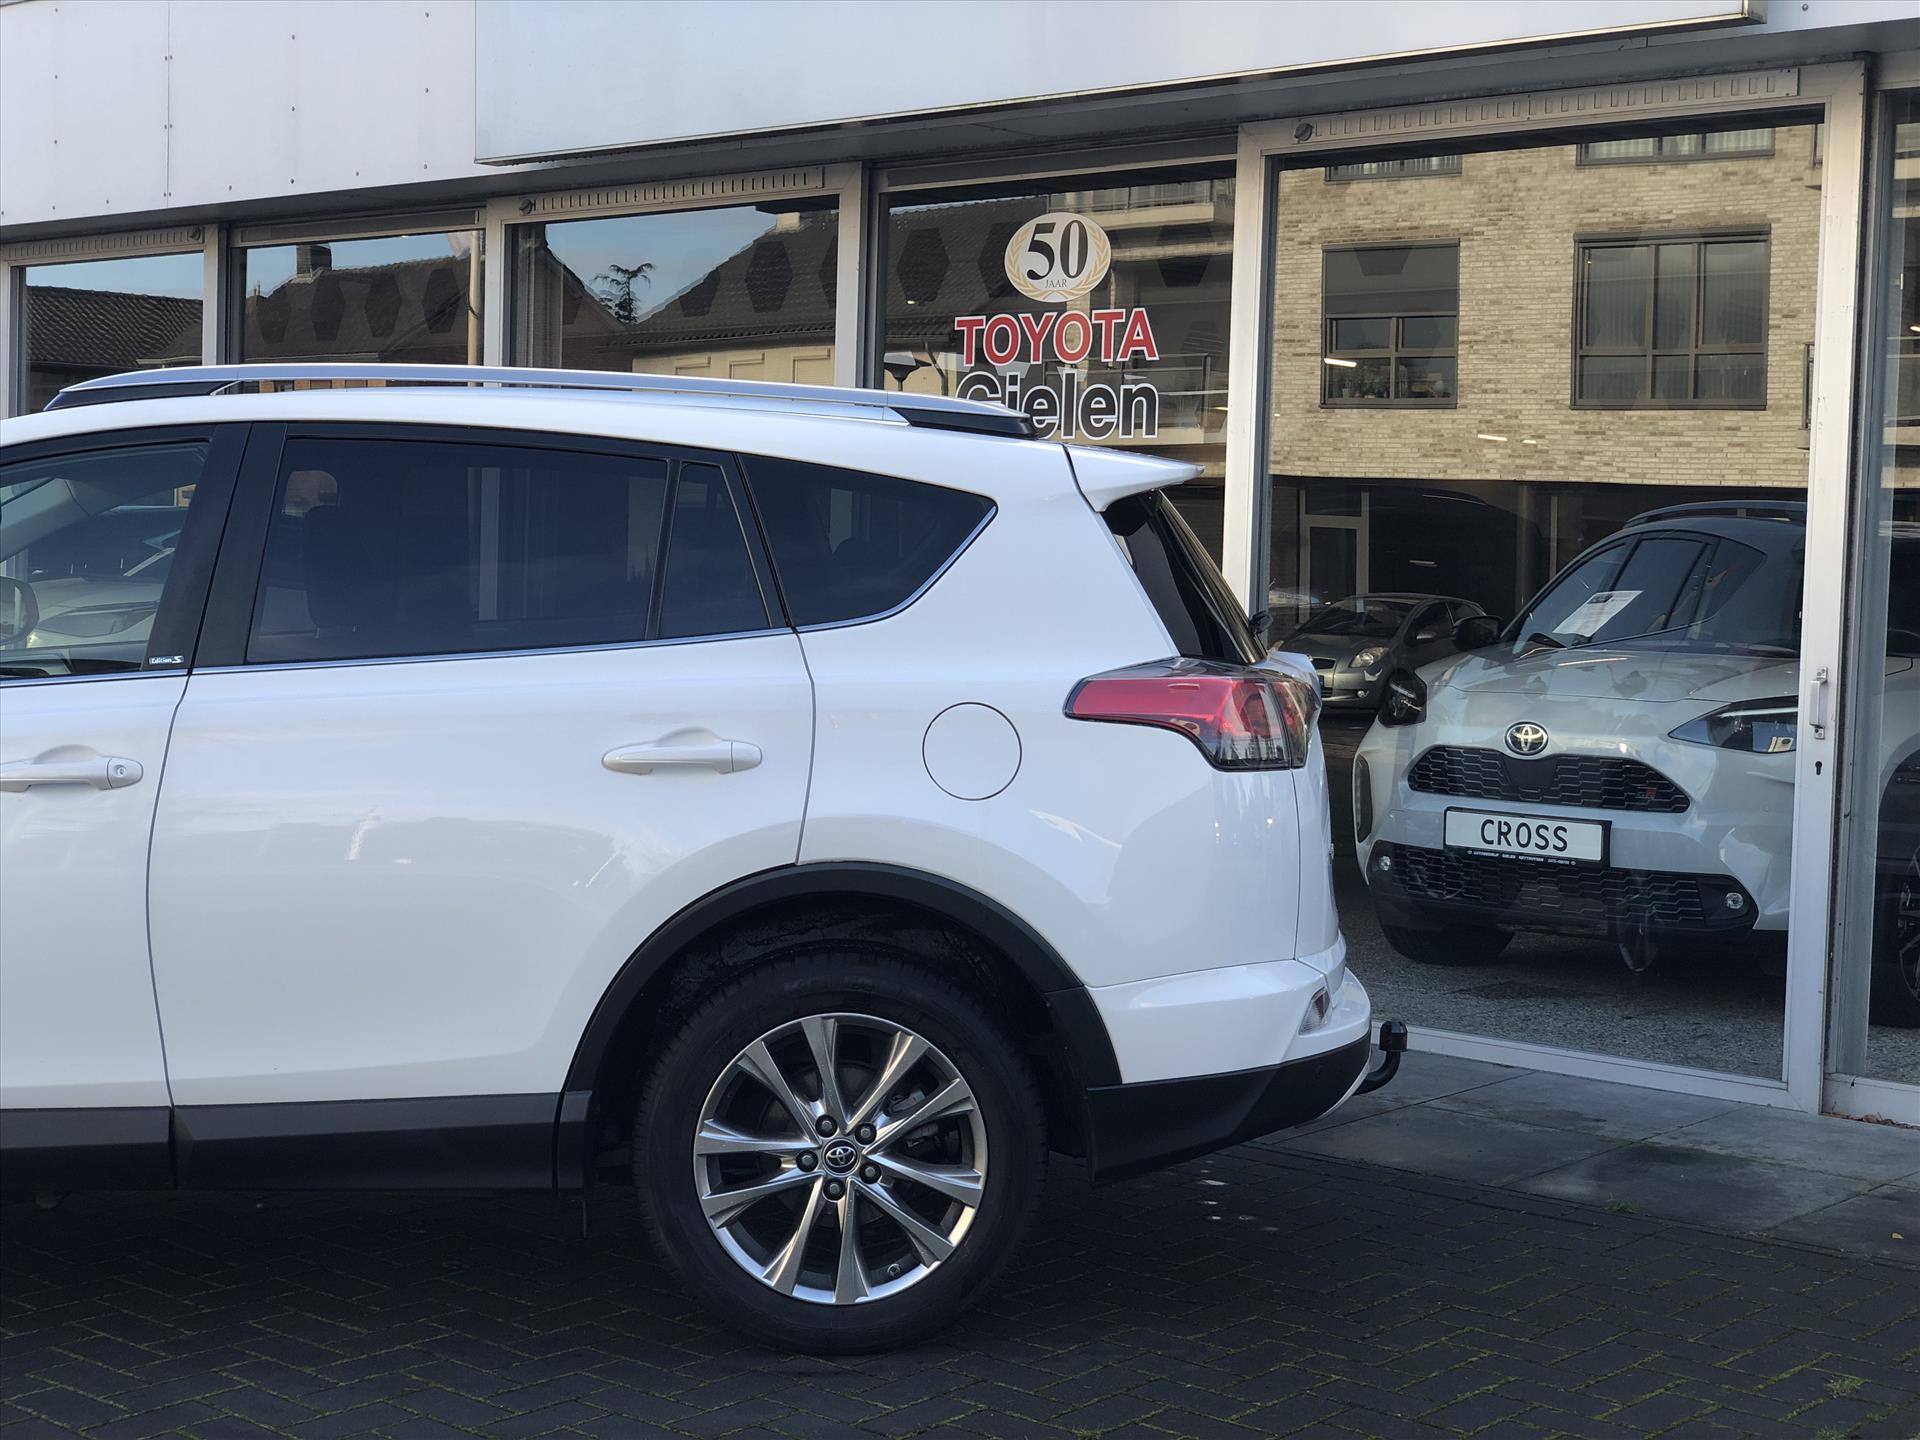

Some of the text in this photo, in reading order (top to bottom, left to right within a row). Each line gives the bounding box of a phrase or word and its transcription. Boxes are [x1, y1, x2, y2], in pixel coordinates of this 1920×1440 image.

[1026, 219, 1089, 280] 50
[1045, 279, 1068, 288] JAAR
[955, 307, 1160, 367] TOYOTA
[1481, 819, 1568, 852] CROSS
